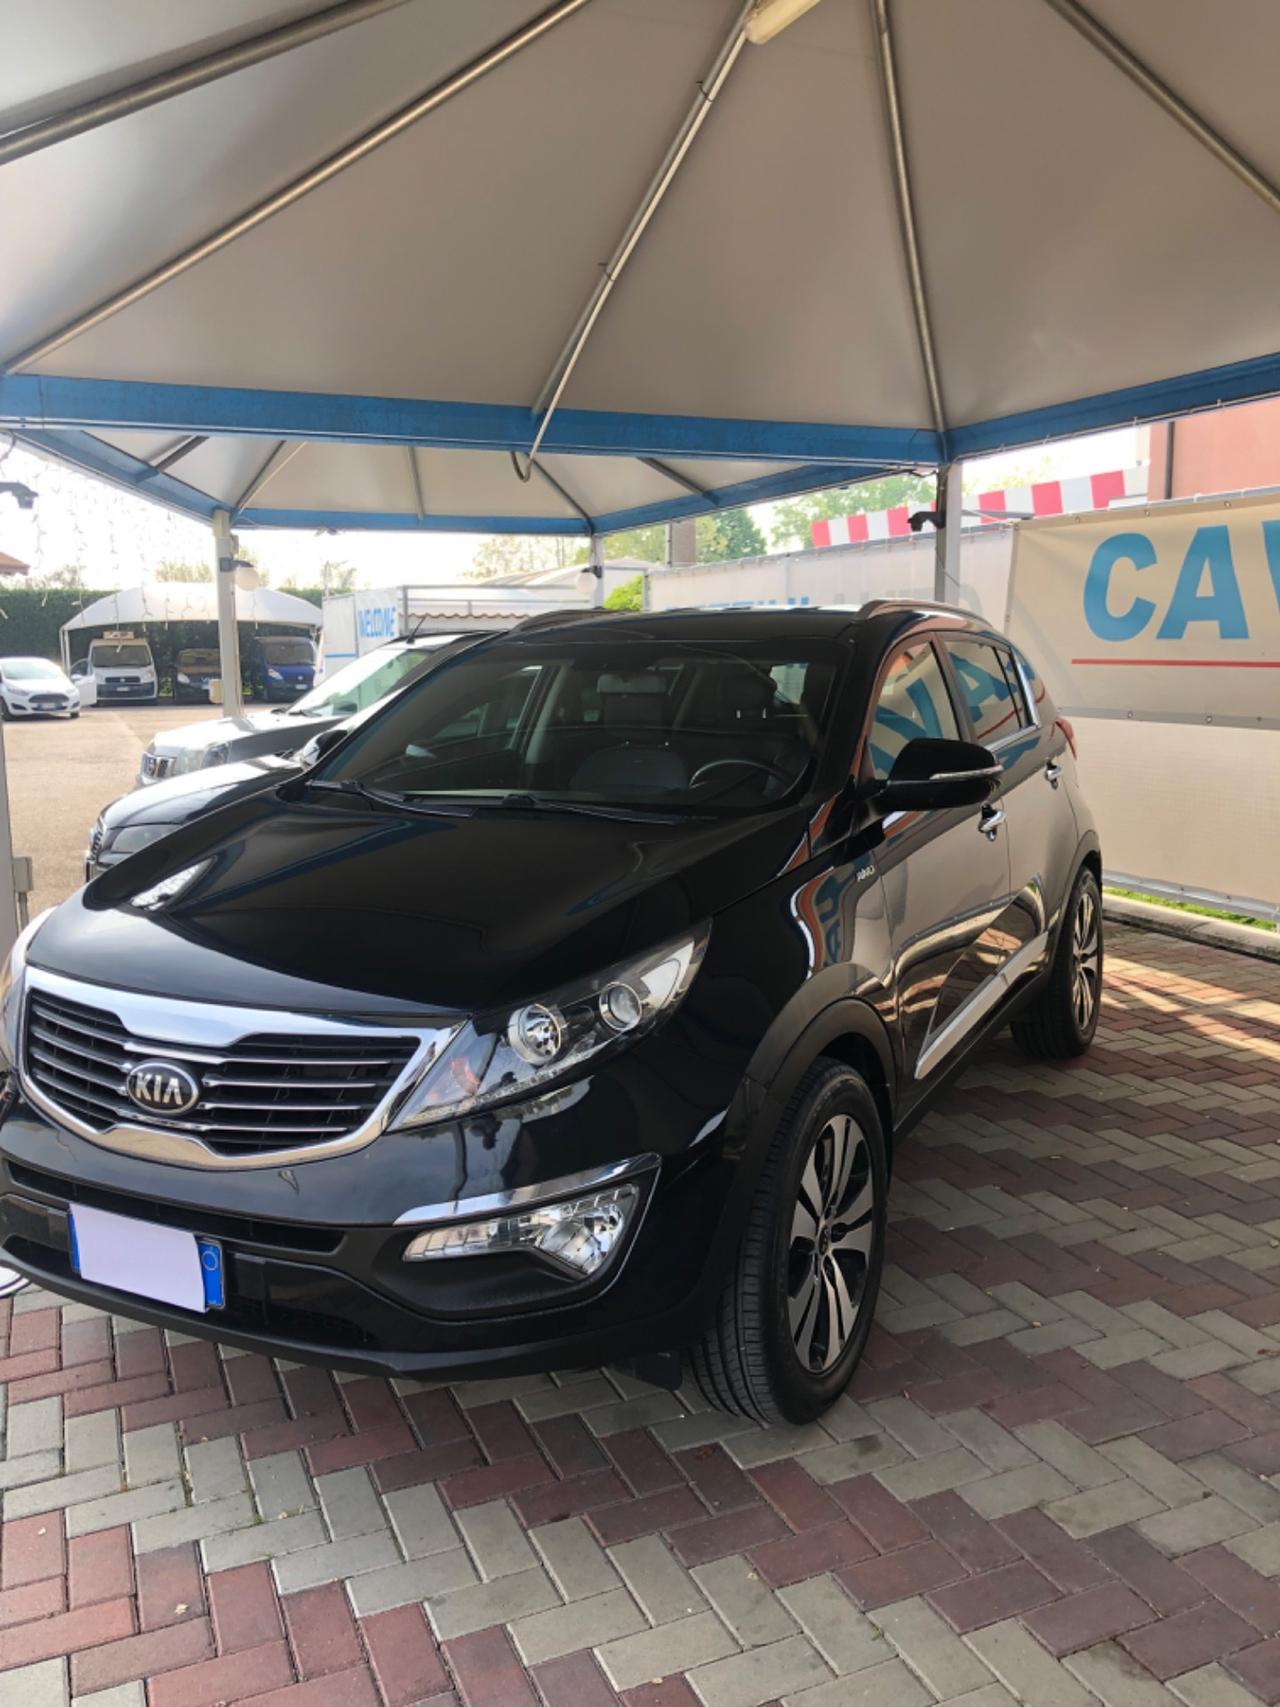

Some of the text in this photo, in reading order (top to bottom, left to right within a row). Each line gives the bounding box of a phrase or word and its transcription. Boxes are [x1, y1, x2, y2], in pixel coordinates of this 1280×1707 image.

[1083, 520, 1280, 642] CA
[358, 606, 396, 638] WELCOME
[135, 1072, 183, 1105] KIA
